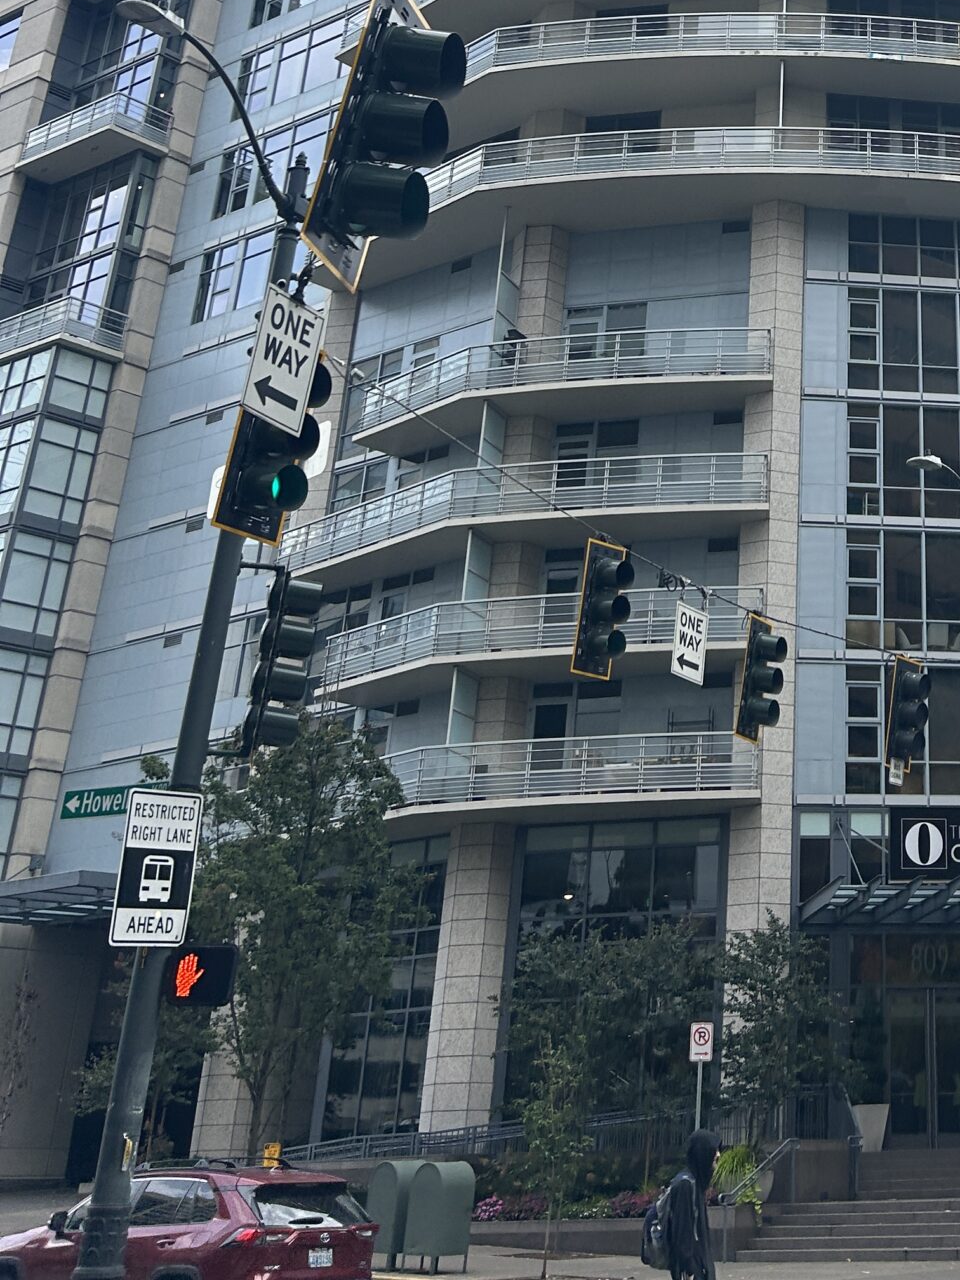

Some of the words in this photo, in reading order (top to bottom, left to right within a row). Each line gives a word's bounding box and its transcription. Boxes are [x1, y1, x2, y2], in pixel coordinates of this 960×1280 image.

[270, 303, 315, 348] ONE
[263, 333, 309, 378] WAY
[680, 612, 703, 634] ONE
[679, 630, 702, 653] WAY
[134, 803, 195, 821] RESTRICTED
[131, 825, 163, 841] RIGHT
[166, 828, 192, 844] LANE
[126, 916, 174, 934] AHEAD
[911, 940, 949, 977] 809
